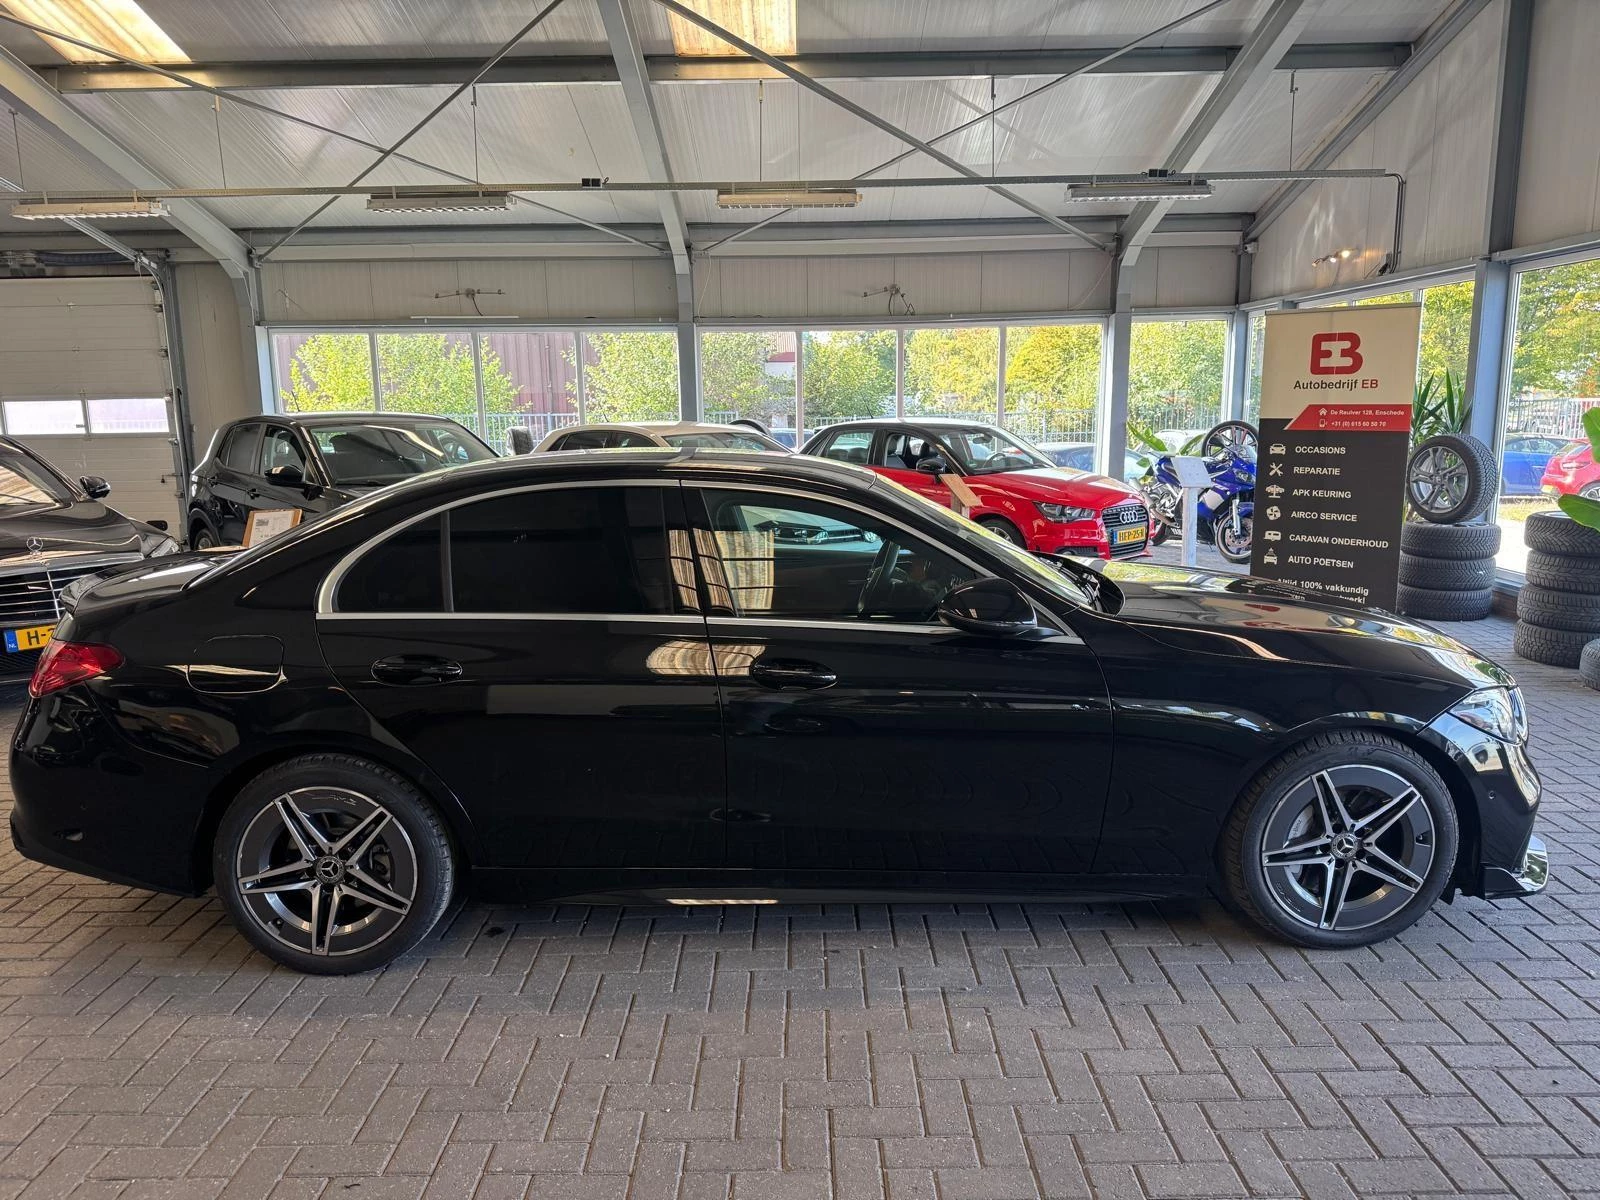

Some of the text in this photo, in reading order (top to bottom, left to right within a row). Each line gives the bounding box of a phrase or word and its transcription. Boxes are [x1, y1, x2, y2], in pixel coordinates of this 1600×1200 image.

[1309, 331, 1364, 375] EB
[1293, 379, 1378, 391] Autobedrijf EB
[1294, 445, 1346, 455] OCCASIONS
[1293, 466, 1341, 476] REPARATIE
[1292, 489, 1352, 499] APK KEURING
[1290, 510, 1358, 522] AIRCO SERVICE
[1289, 533, 1389, 549] CARAVAN ONDERHOUD
[1287, 555, 1354, 569] AUTO POETSEN
[1300, 580, 1323, 590] 100%
[1325, 583, 1369, 596] vakkundig
